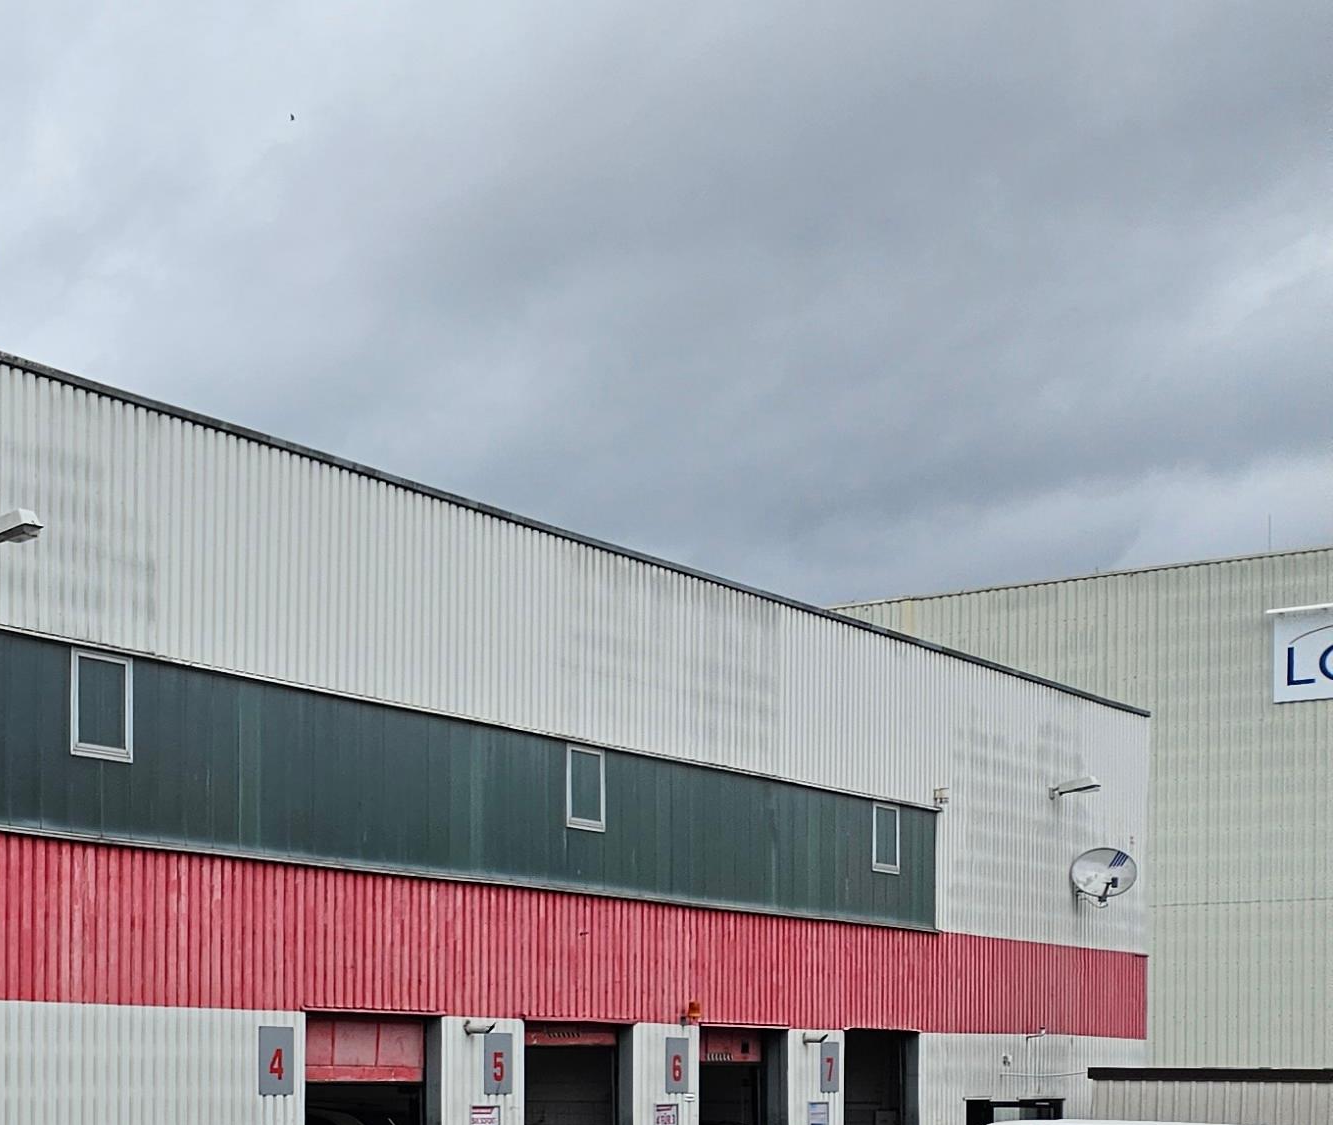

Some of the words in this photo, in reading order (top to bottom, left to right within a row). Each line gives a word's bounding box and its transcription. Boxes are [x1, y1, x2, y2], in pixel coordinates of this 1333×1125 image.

[269, 1048, 284, 1080] 4
[493, 1052, 504, 1081] 5
[672, 1054, 682, 1081] 6
[825, 1057, 834, 1082] 7
